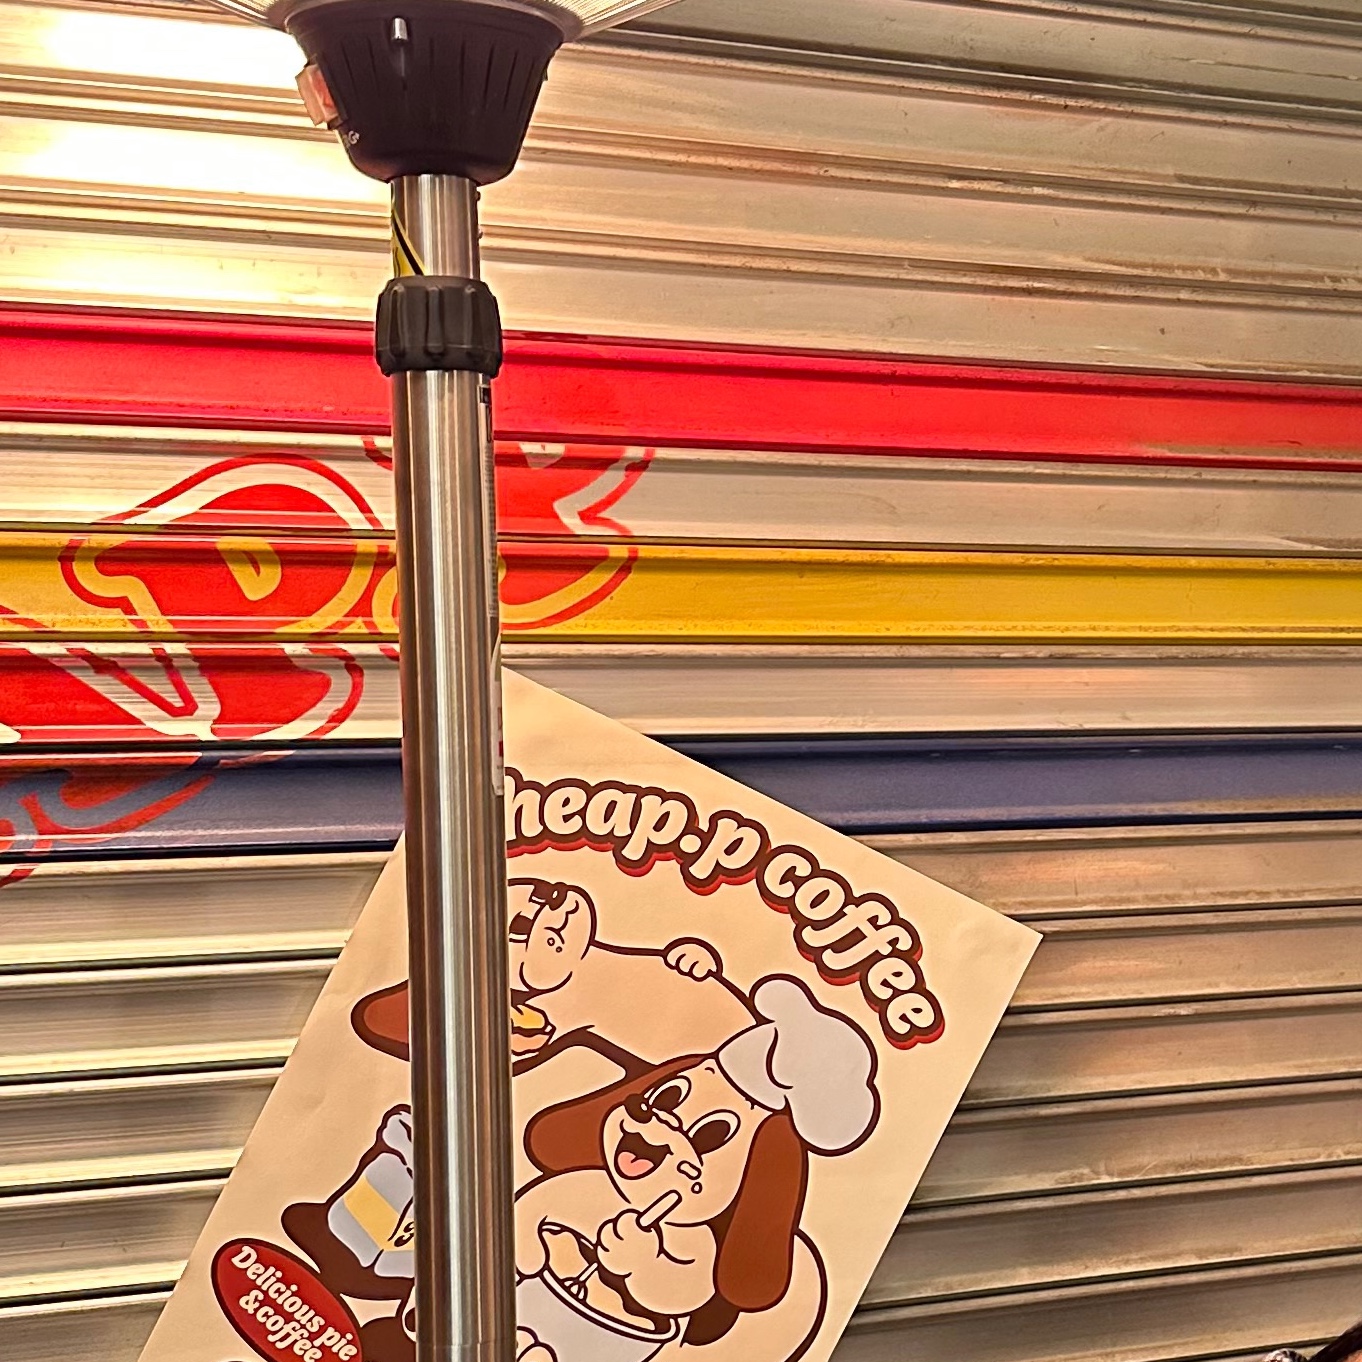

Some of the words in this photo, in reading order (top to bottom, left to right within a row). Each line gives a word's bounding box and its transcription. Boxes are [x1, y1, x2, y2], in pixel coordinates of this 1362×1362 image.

[760, 848, 941, 1042] coffee
[231, 1245, 326, 1333] Delicious
[313, 1326, 358, 1361] pie
